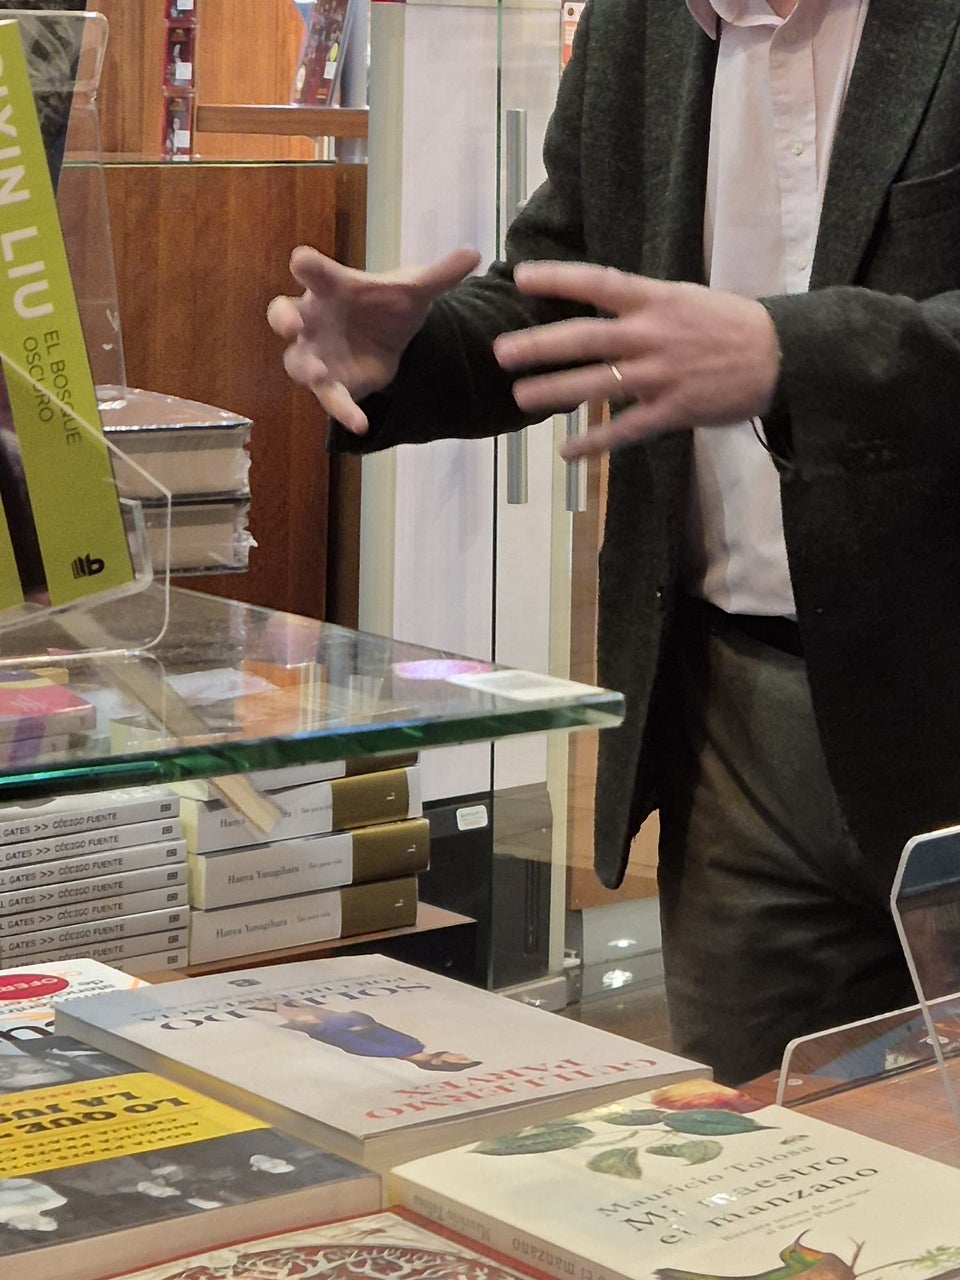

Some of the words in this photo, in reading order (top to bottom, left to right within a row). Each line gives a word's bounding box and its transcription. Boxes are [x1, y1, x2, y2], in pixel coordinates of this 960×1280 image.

[1, 225, 54, 319] LIU
[44, 329, 61, 355] EL
[23, 335, 54, 423] OSCURO
[50, 359, 82, 446] BOSQUE
[3, 826, 31, 836] GATES
[52, 817, 85, 829] CÓDIGO
[86, 812, 118, 823] FUENTE
[6, 849, 33, 860] GATES
[54, 840, 86, 852] CÓDIGO
[88, 835, 119, 846] FUENTE
[10, 873, 37, 884] GATES
[58, 863, 90, 876] CÓDIGO
[92, 858, 124, 869] FUENTE
[228, 873, 255, 886] Hanya
[257, 865, 300, 880] Yanagihara
[8, 896, 36, 907] GATES
[58, 886, 90, 899] CÓDIGO
[92, 881, 124, 892] FUENTE
[8, 918, 35, 929] GATES
[57, 908, 90, 920] CÓDIGO
[92, 903, 124, 913] FUENTE
[216, 927, 242, 939] Hanya
[245, 919, 288, 934] Yanagihara
[8, 939, 36, 951] GATES
[59, 929, 91, 942] CÓDIGO
[93, 924, 125, 935] FUENTE
[93, 945, 125, 956] FUENTE
[160, 985, 431, 1031] SOLDADO
[71, 1091, 141, 1108] LA
[365, 1059, 657, 1120] GUILLERMO
[123, 1098, 190, 1114] LO
[14, 1112, 117, 1135] QUE
[598, 1174, 723, 1217] Mauricio
[724, 1145, 816, 1173] Tolosa
[621, 1204, 686, 1232] Mi
[697, 1155, 849, 1208] maestro
[706, 1167, 880, 1228] manzano
[512, 1237, 576, 1277] manzano
